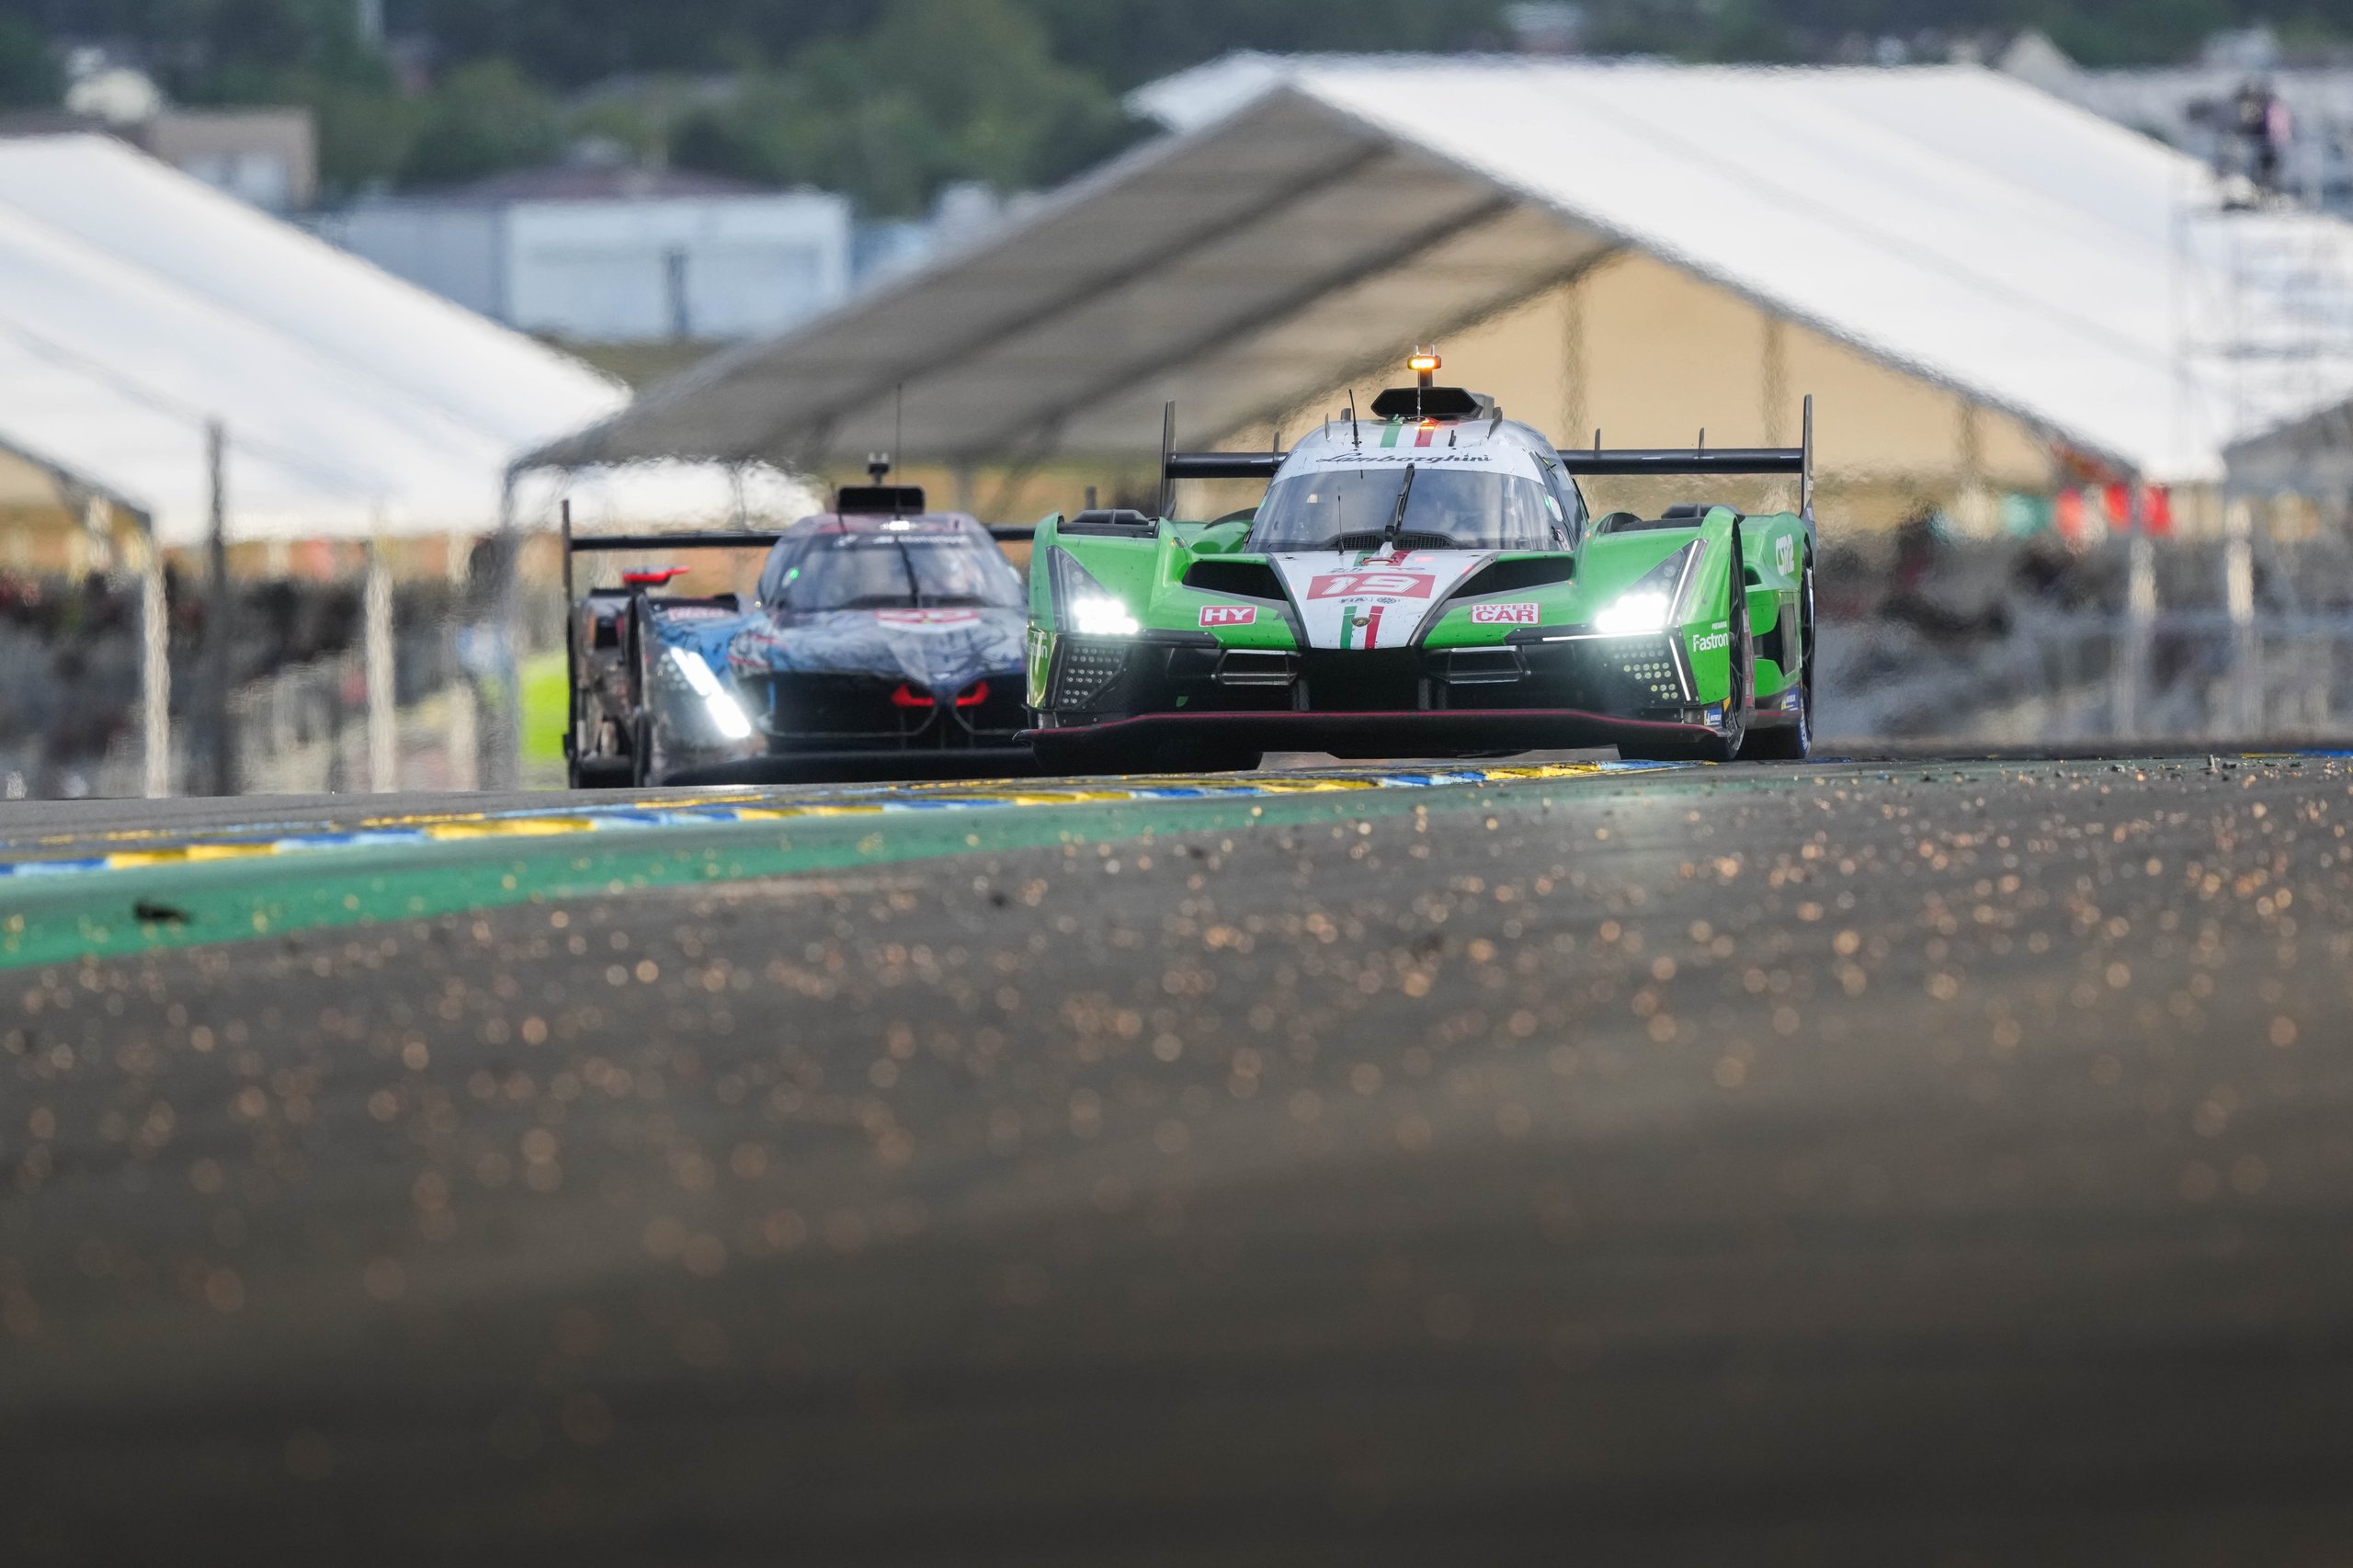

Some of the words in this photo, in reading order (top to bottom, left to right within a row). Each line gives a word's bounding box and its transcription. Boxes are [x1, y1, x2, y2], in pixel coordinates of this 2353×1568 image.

[1316, 452, 1493, 463] Lamborghini
[1322, 575, 1419, 595] 19
[1205, 608, 1252, 622] HY
[1475, 610, 1534, 621] CAR
[1693, 632, 1728, 652] Fastron
